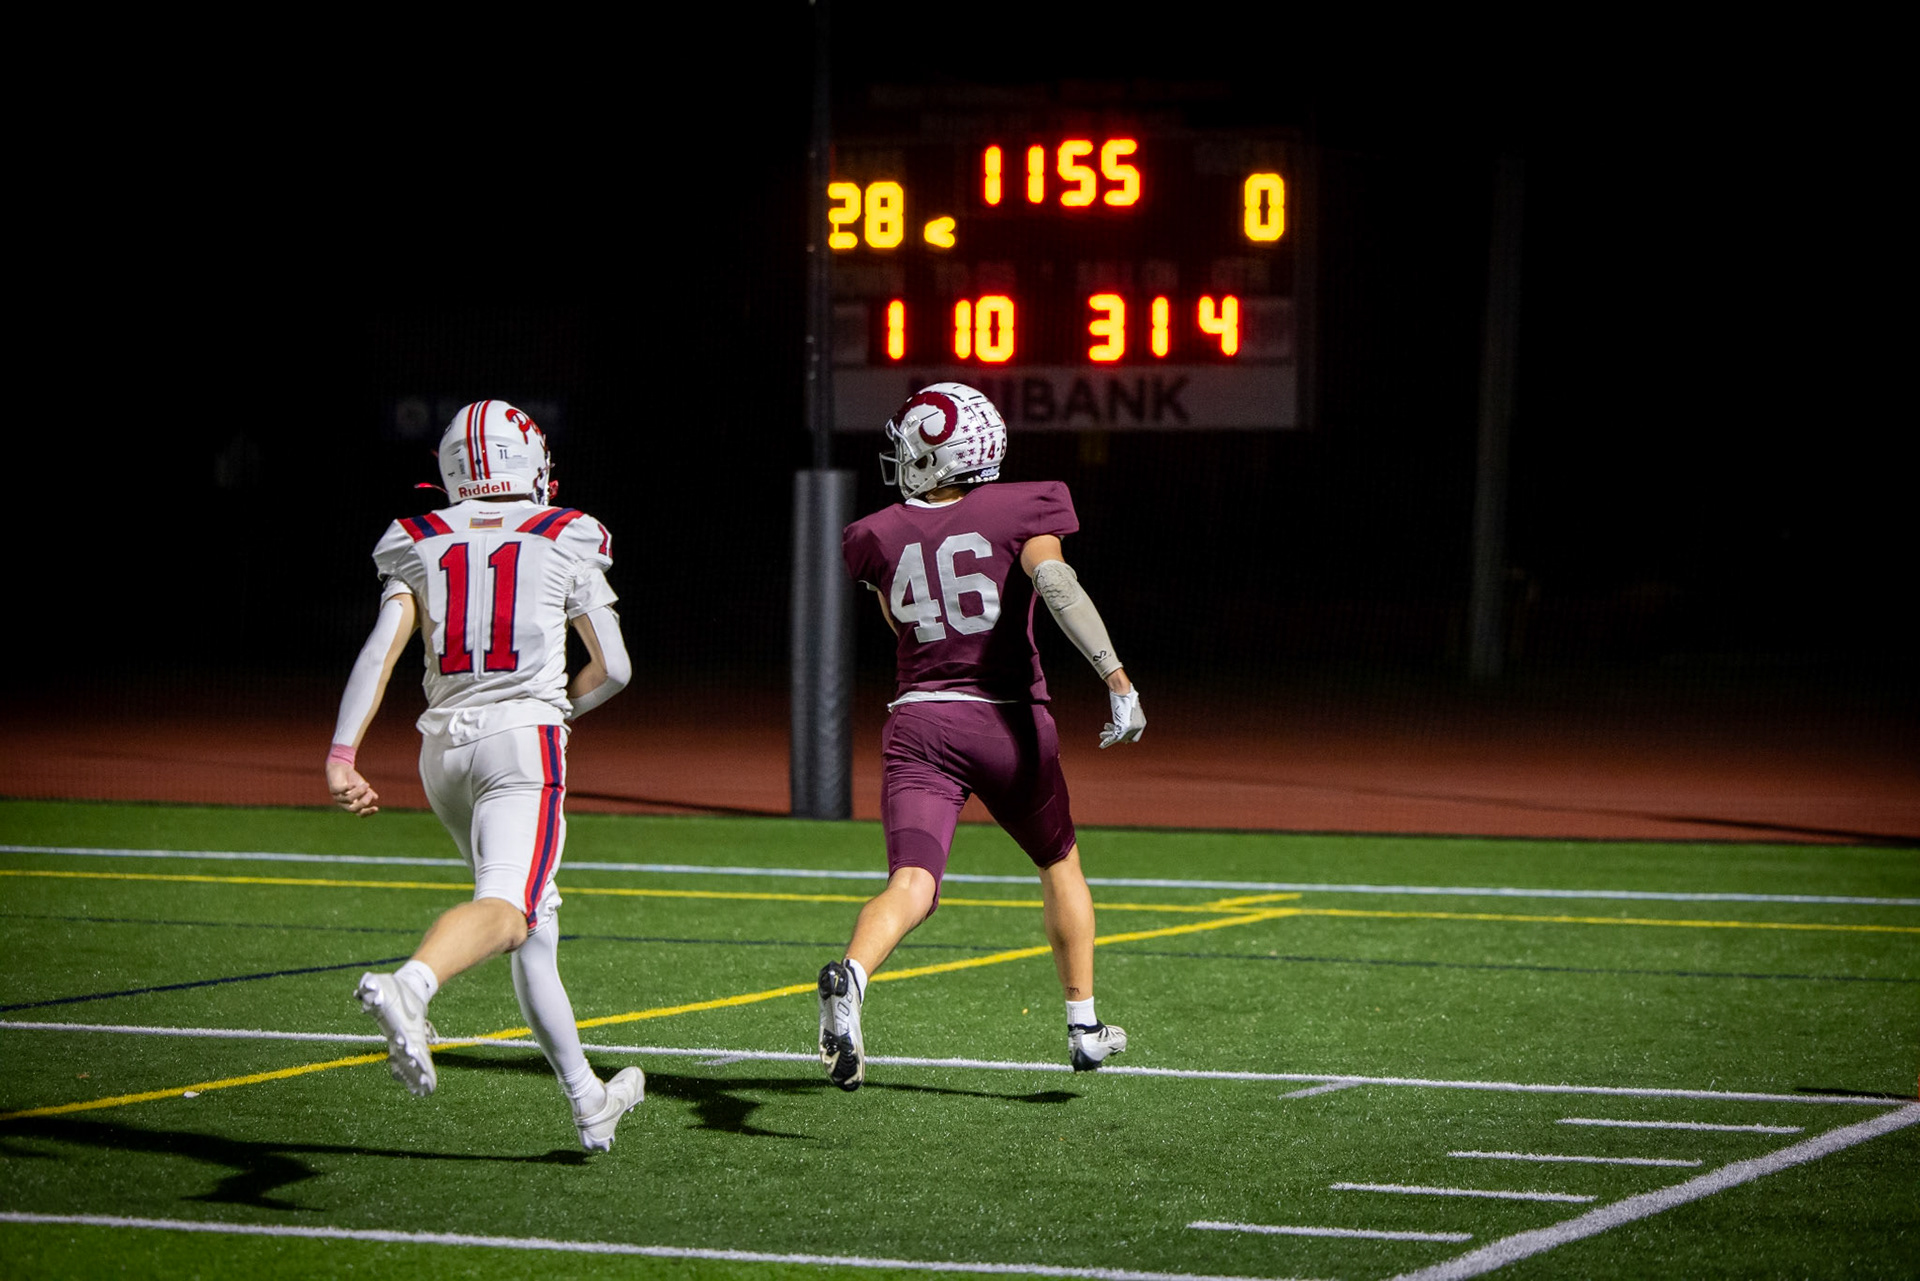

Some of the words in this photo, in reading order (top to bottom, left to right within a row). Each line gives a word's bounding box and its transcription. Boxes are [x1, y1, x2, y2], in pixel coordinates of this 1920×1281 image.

[827, 181, 904, 250] 28
[1243, 172, 1285, 242] 0
[887, 299, 905, 360] 1
[954, 295, 1015, 363] 10
[908, 374, 1190, 423] IBANK
[458, 481, 511, 498] Riddell
[438, 540, 522, 676] 11
[890, 531, 1002, 644] 46
